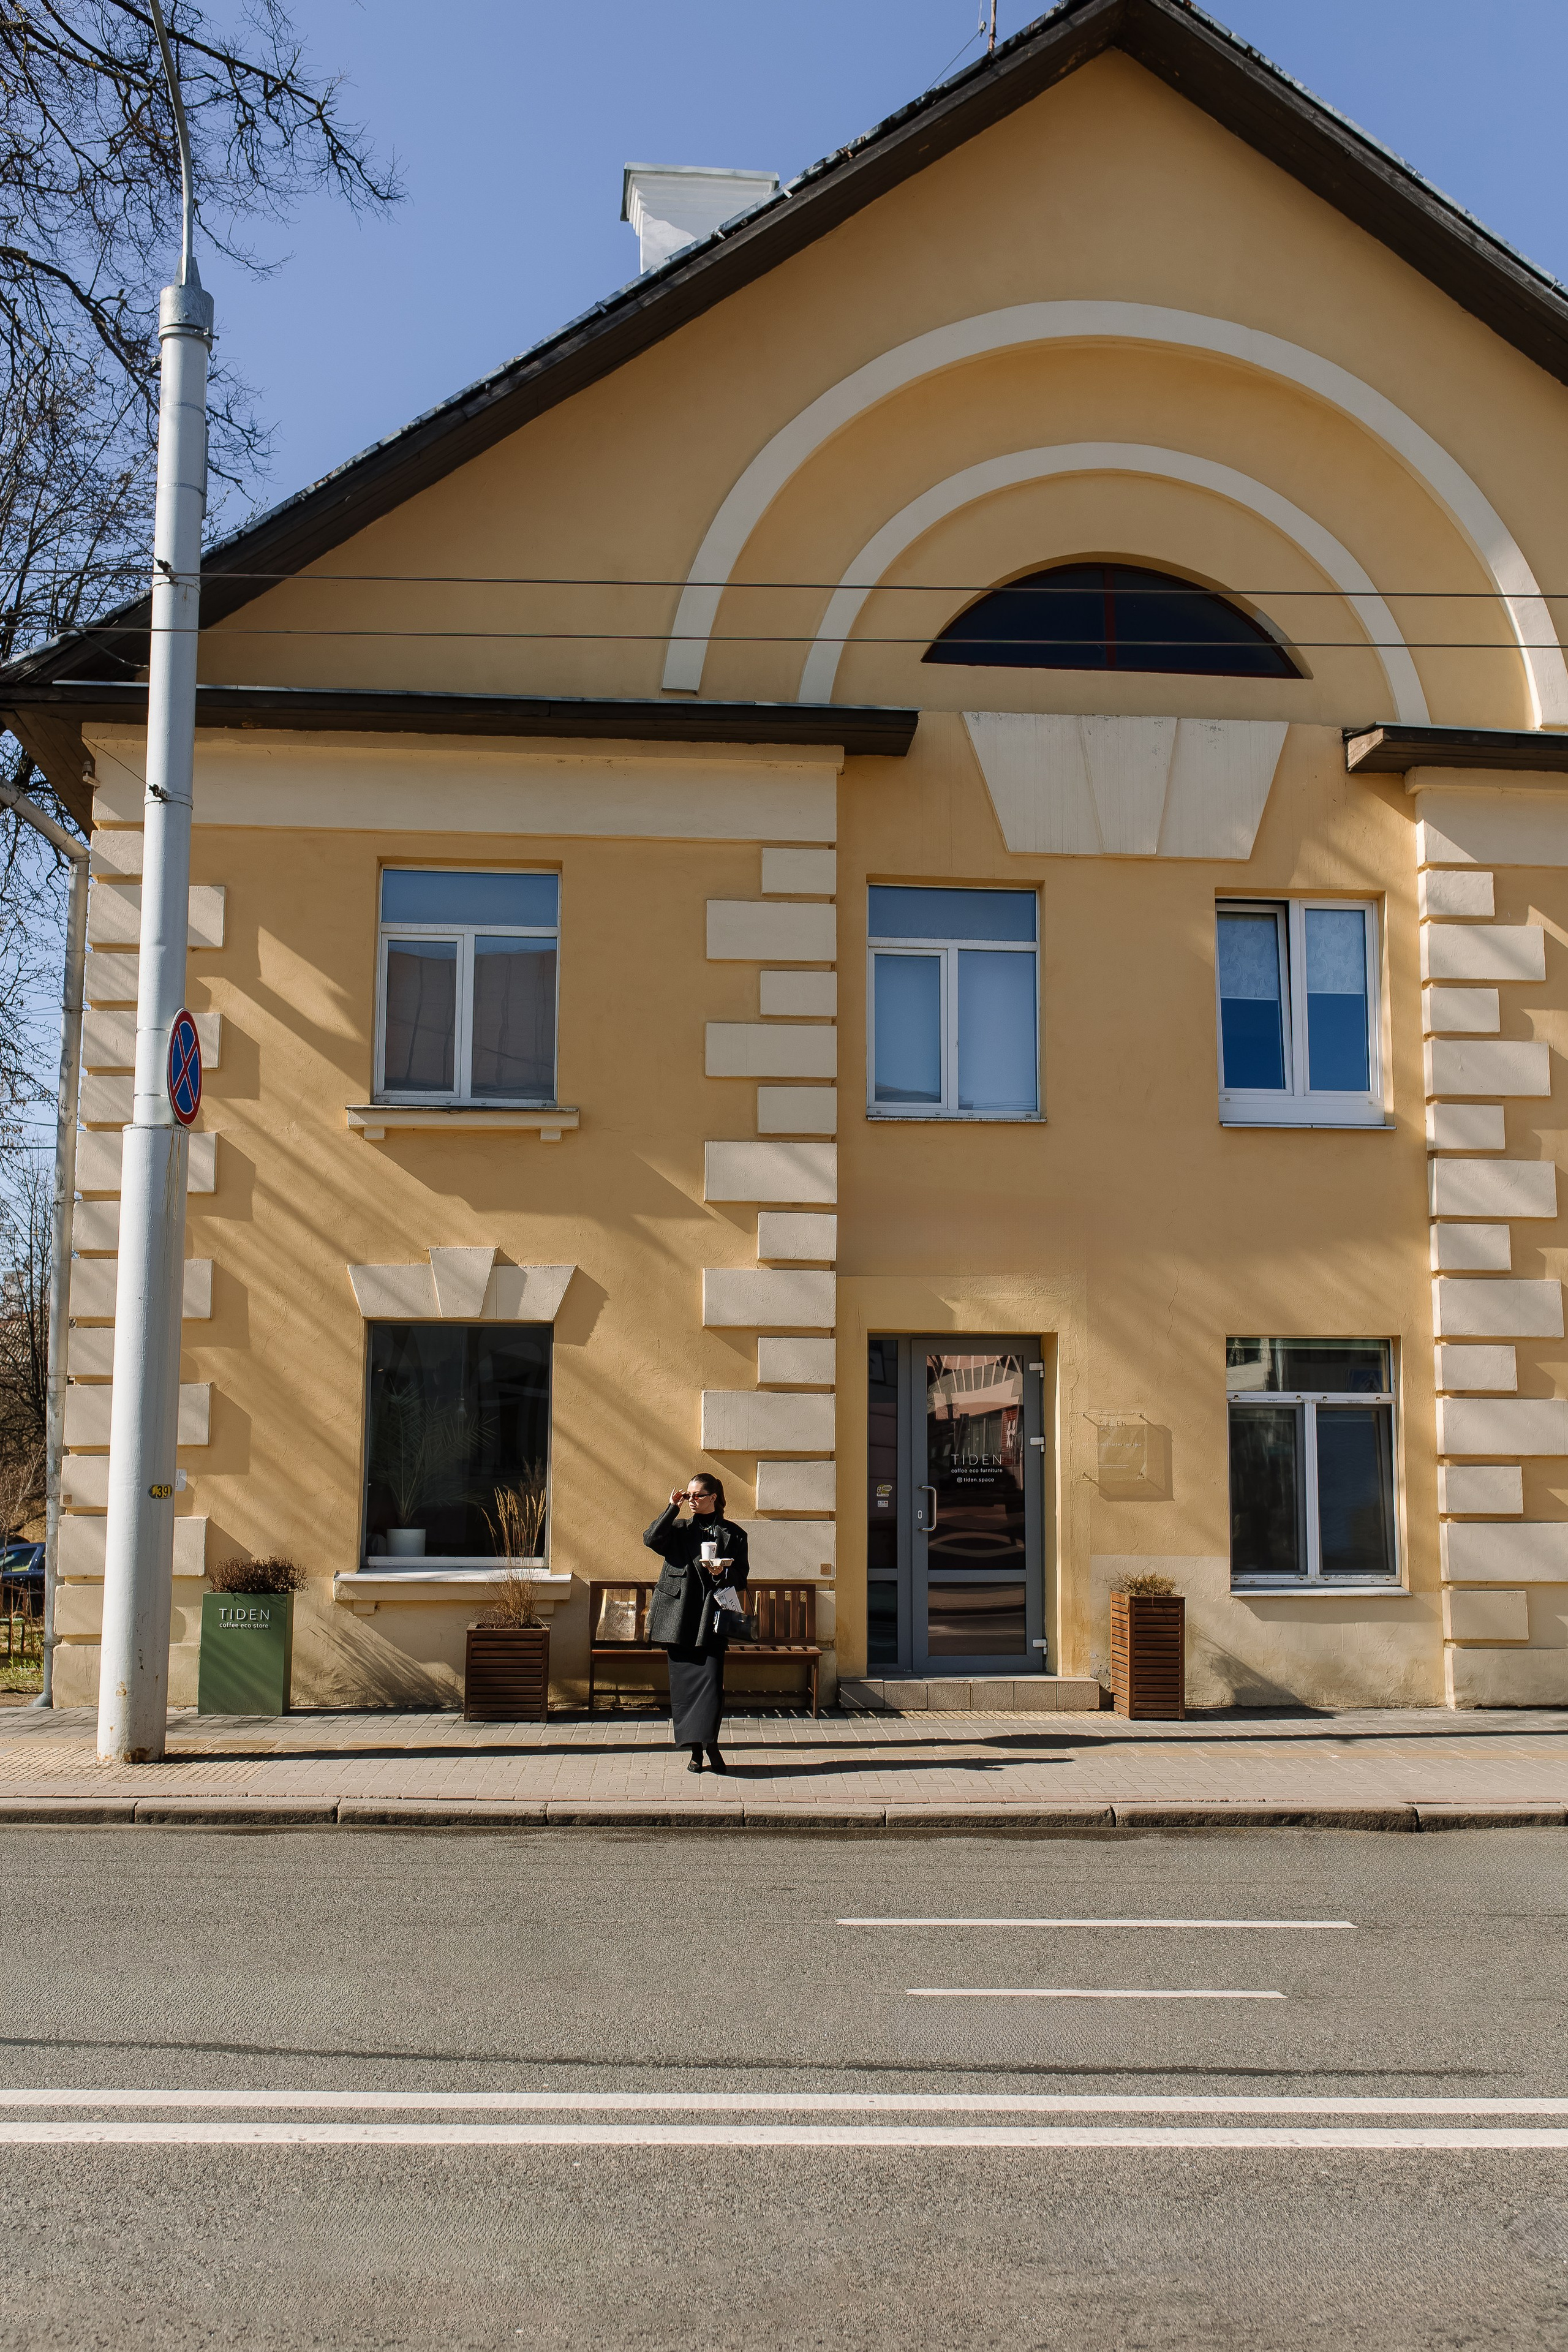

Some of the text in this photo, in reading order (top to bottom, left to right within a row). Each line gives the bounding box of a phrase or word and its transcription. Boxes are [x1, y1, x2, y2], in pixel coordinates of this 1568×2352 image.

[951, 1454, 1001, 1465] TIDEN
[157, 1485, 168, 1498] 39
[218, 1608, 270, 1620] TIDEN
